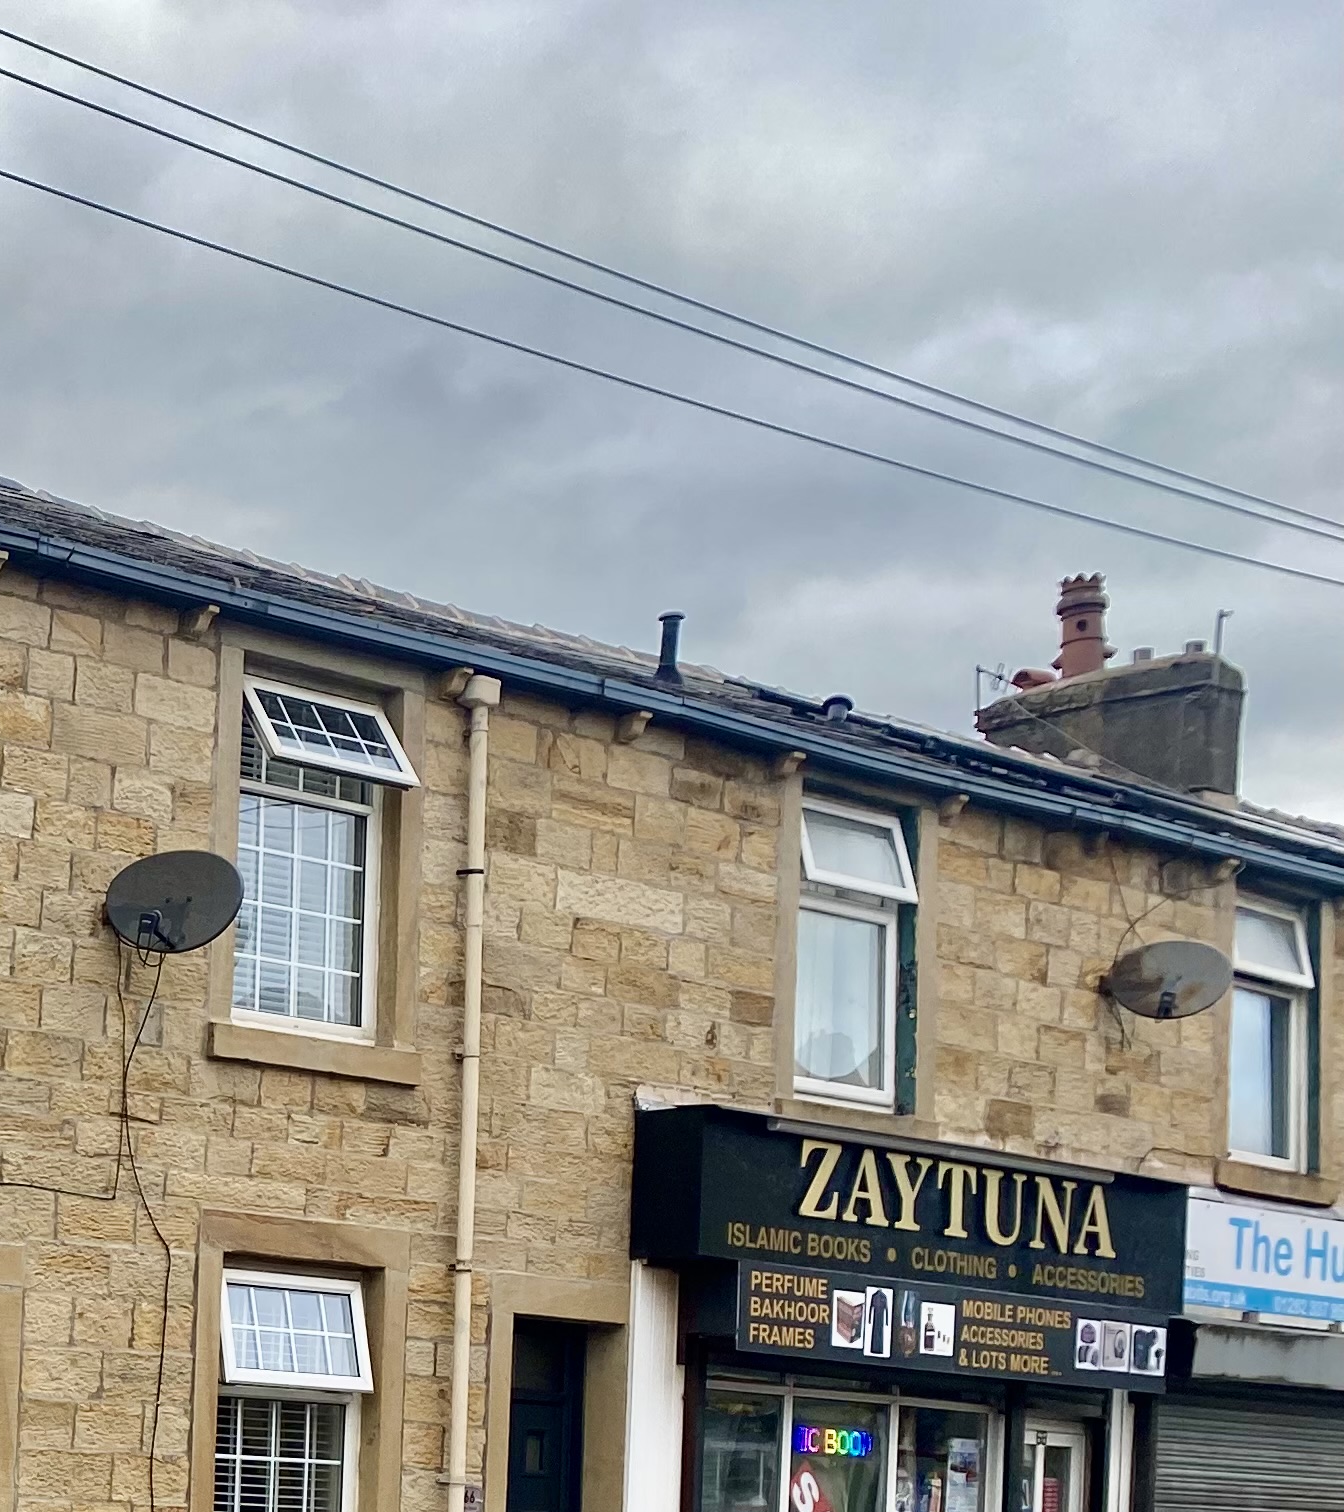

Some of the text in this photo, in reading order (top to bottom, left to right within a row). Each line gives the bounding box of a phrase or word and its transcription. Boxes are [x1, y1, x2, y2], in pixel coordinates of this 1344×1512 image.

[798, 1139, 1116, 1259] ZAYTUNA
[727, 1222, 1145, 1298] ISLAMIC BOOKS CLOTHING ACCESSORIES
[1228, 1217, 1293, 1277] The
[751, 1270, 828, 1299] PERFUME
[750, 1297, 830, 1325] BAKHOOR
[962, 1300, 1072, 1329] MOBILE PHONES
[749, 1322, 815, 1350] FRAMES
[960, 1324, 1044, 1351] ACCESSORIES
[958, 1348, 968, 1367] &
[972, 1350, 1007, 1371] LOTS
[464, 1489, 475, 1504] 66
